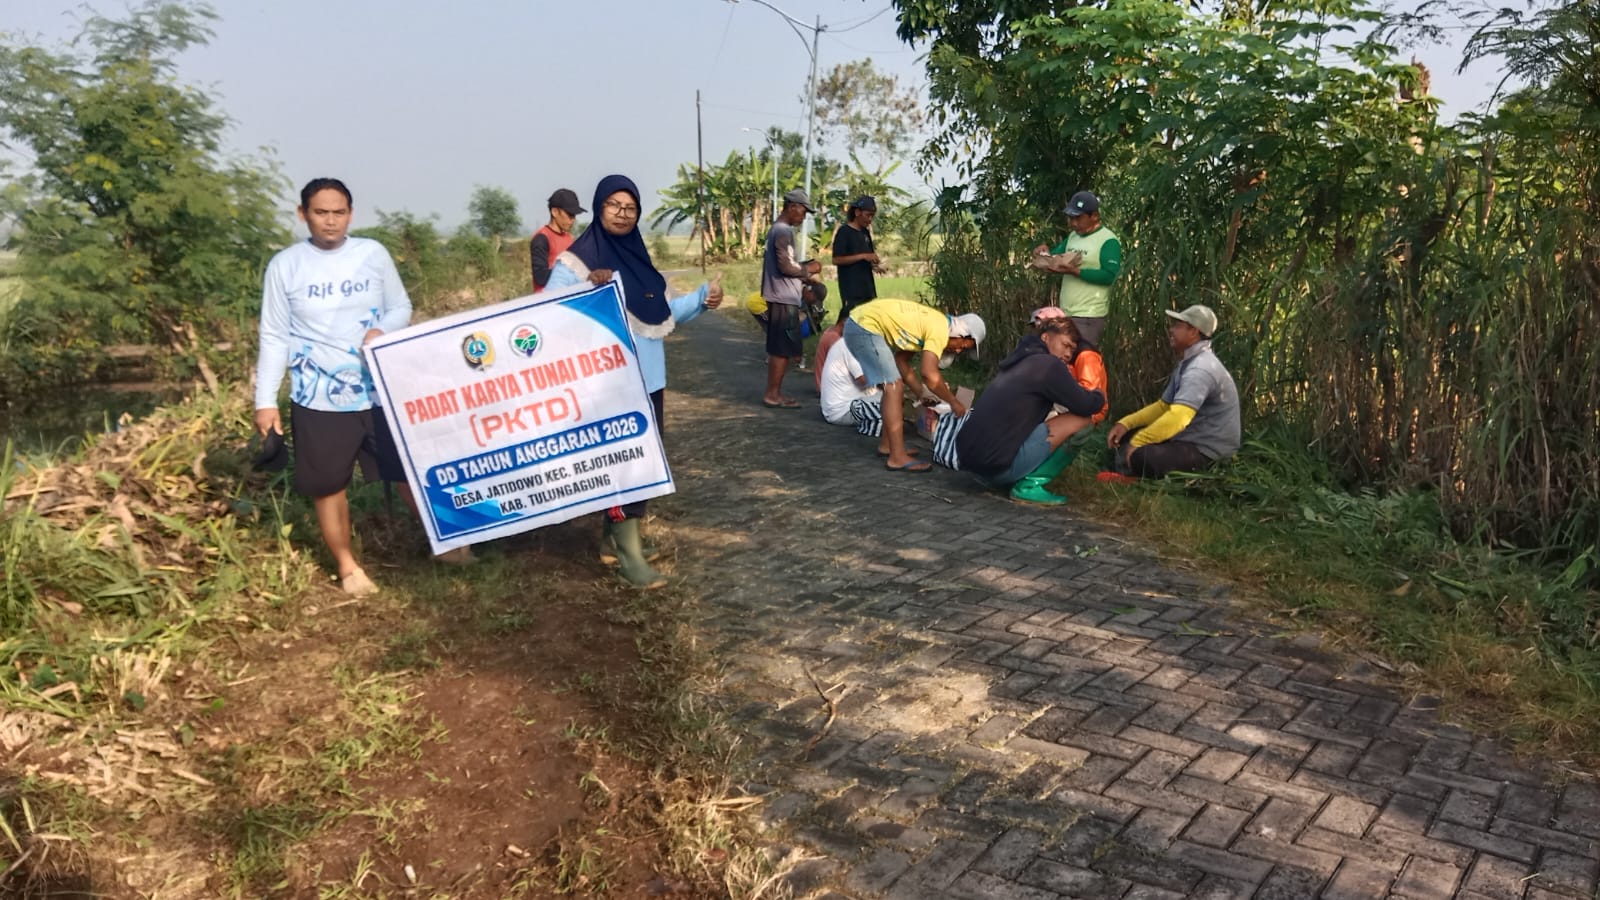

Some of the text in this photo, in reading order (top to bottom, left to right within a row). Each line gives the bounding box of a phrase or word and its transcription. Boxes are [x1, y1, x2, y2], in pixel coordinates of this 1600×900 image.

[308, 279, 370, 299] Rjt Go!
[404, 343, 628, 424] PADAT KARYA TUNAI DESA
[436, 416, 639, 485] DD TAHUN ANGGARAN 2026
[453, 446, 645, 508] DESA JATIDOWO KEC. REJOTANGAN
[500, 474, 612, 515] KAB. TULUNGAGUNG
